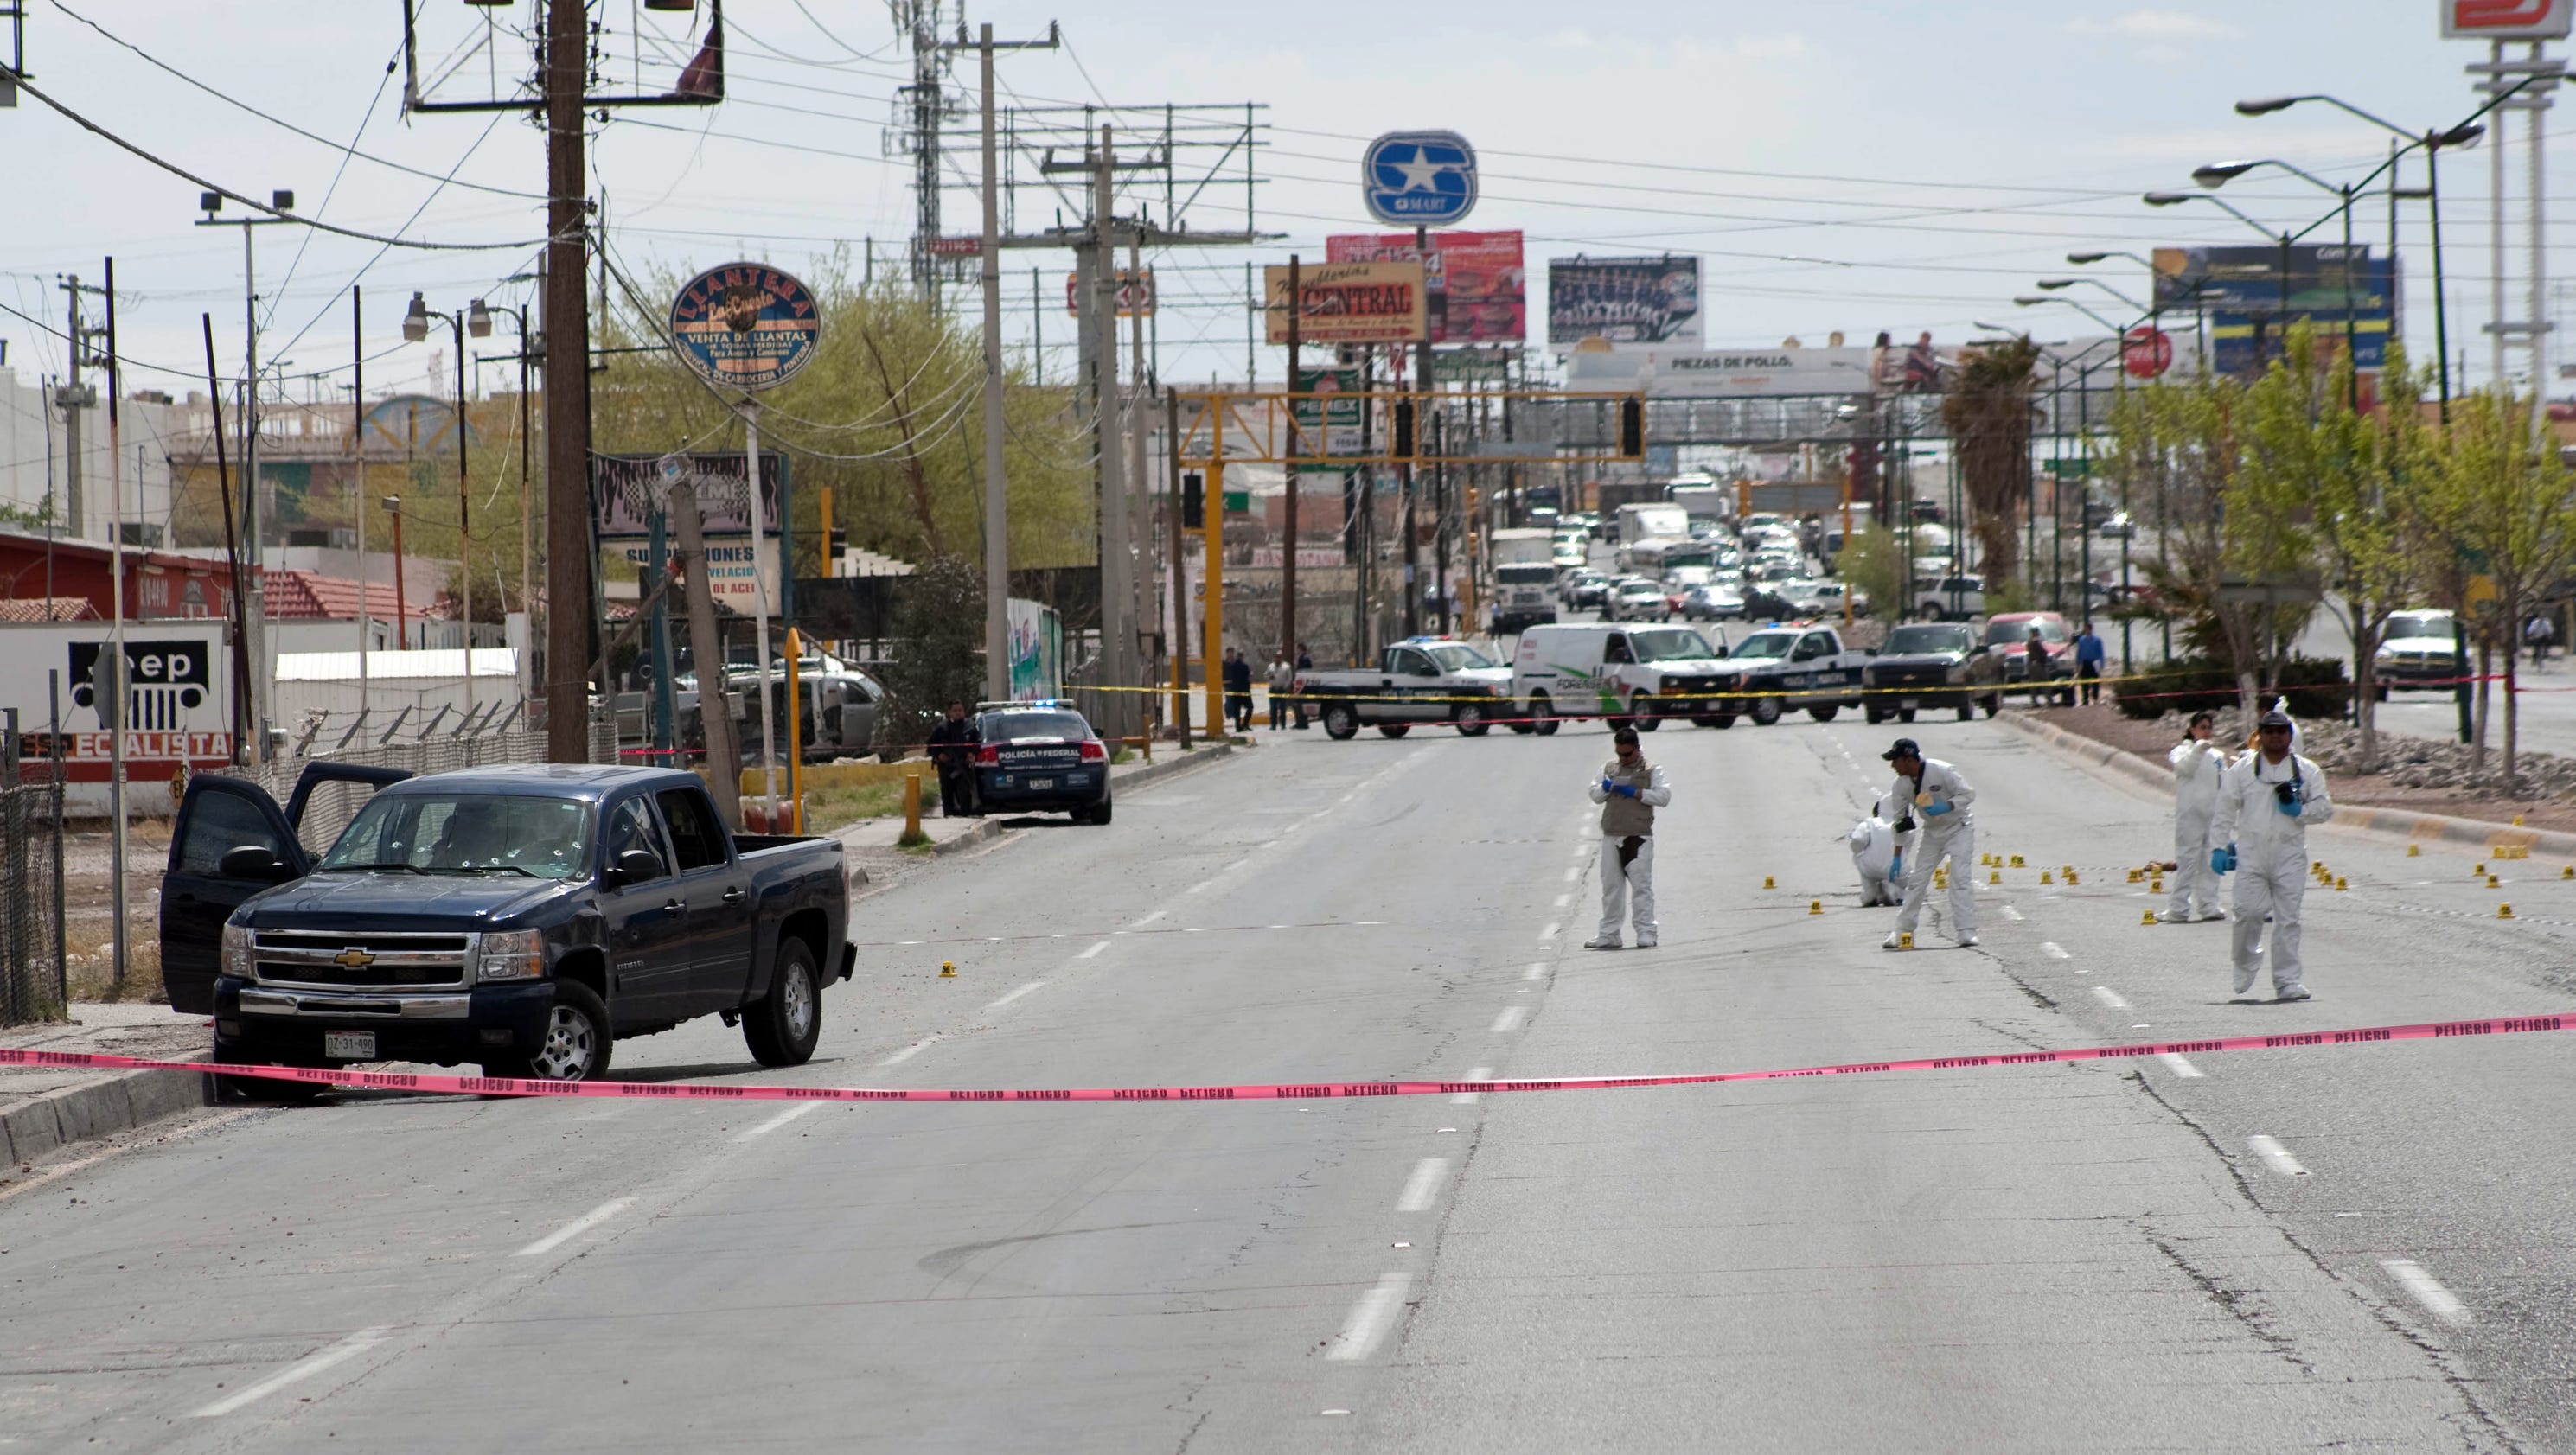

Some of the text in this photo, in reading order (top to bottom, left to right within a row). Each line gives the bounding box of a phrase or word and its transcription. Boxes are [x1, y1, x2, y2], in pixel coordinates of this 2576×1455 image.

[2317, 246, 2366, 259] Comx
[679, 269, 810, 319] LLANTERA
[1304, 285, 1412, 316] CENTRAL
[688, 331, 807, 343] VENTA DE LLANTAS
[783, 341, 812, 372] PINTURA
[1672, 357, 1721, 369] PIEZAS
[1724, 357, 1741, 368] DE
[19, 733, 228, 757] ESPECALISTA
[999, 748, 1080, 760] POLICÍA FEDERAL
[2435, 1018, 2560, 1037] PELIGRO PELIGRO
[2266, 1030, 2390, 1047] PELIGRO PELIGRO
[37, 1051, 91, 1063] PELIGRO
